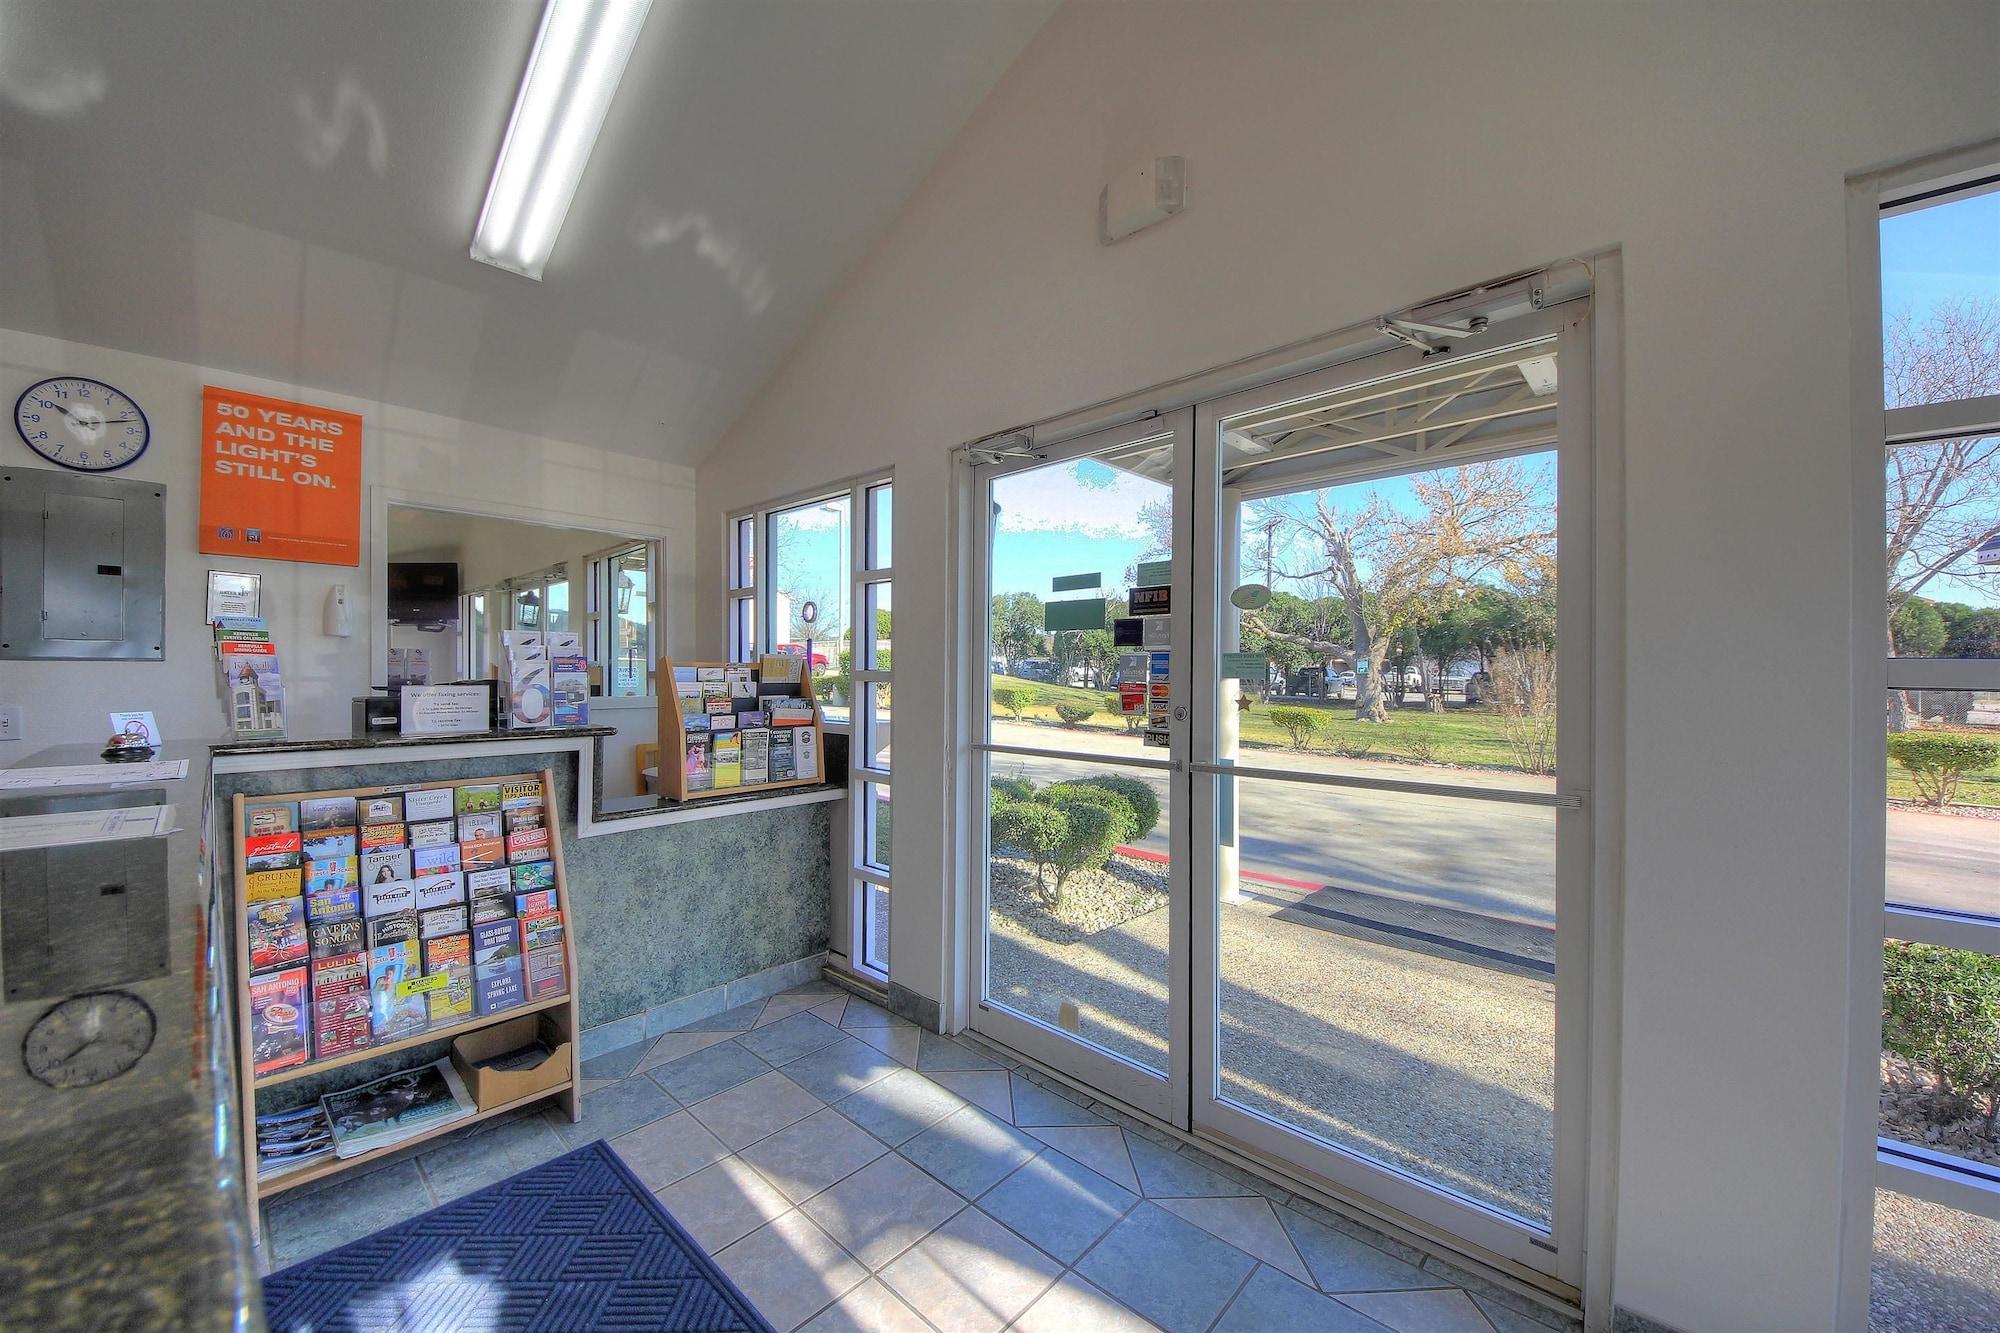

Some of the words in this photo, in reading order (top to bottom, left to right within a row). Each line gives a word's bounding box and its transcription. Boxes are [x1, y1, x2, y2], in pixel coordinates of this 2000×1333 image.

[55, 388, 68, 399] 11
[77, 388, 91, 398] 12
[38, 399, 52, 410] 10
[106, 397, 110, 406] 1
[32, 414, 40, 422] 9
[120, 410, 129, 420] 2
[216, 402, 250, 420] 50
[259, 408, 344, 436] YEARS
[39, 430, 48, 440] 8
[126, 427, 134, 436] 3
[216, 422, 276, 442] AND
[285, 432, 334, 453] THE
[56, 444, 64, 452] 7
[120, 440, 128, 450] 4
[80, 450, 88, 460] 6
[104, 450, 112, 460] 5
[216, 440, 318, 468] LIGHT'S
[216, 460, 284, 482] STILL
[293, 471, 336, 489] ON.
[1146, 734, 1169, 745] PUSH
[505, 784, 540, 793] VISITOR
[368, 853, 402, 862] Tanger
[427, 852, 455, 864] wild
[257, 872, 298, 882] GRUENE
[311, 902, 355, 915] Antonio
[313, 922, 360, 938] CAVERNS
[315, 933, 358, 947] SONORA
[252, 985, 267, 995] SAN
[268, 978, 299, 992] ANTONIO
[492, 977, 512, 988] EXPLORE
[488, 988, 504, 999] SPRING
[505, 986, 518, 994] LAKE
